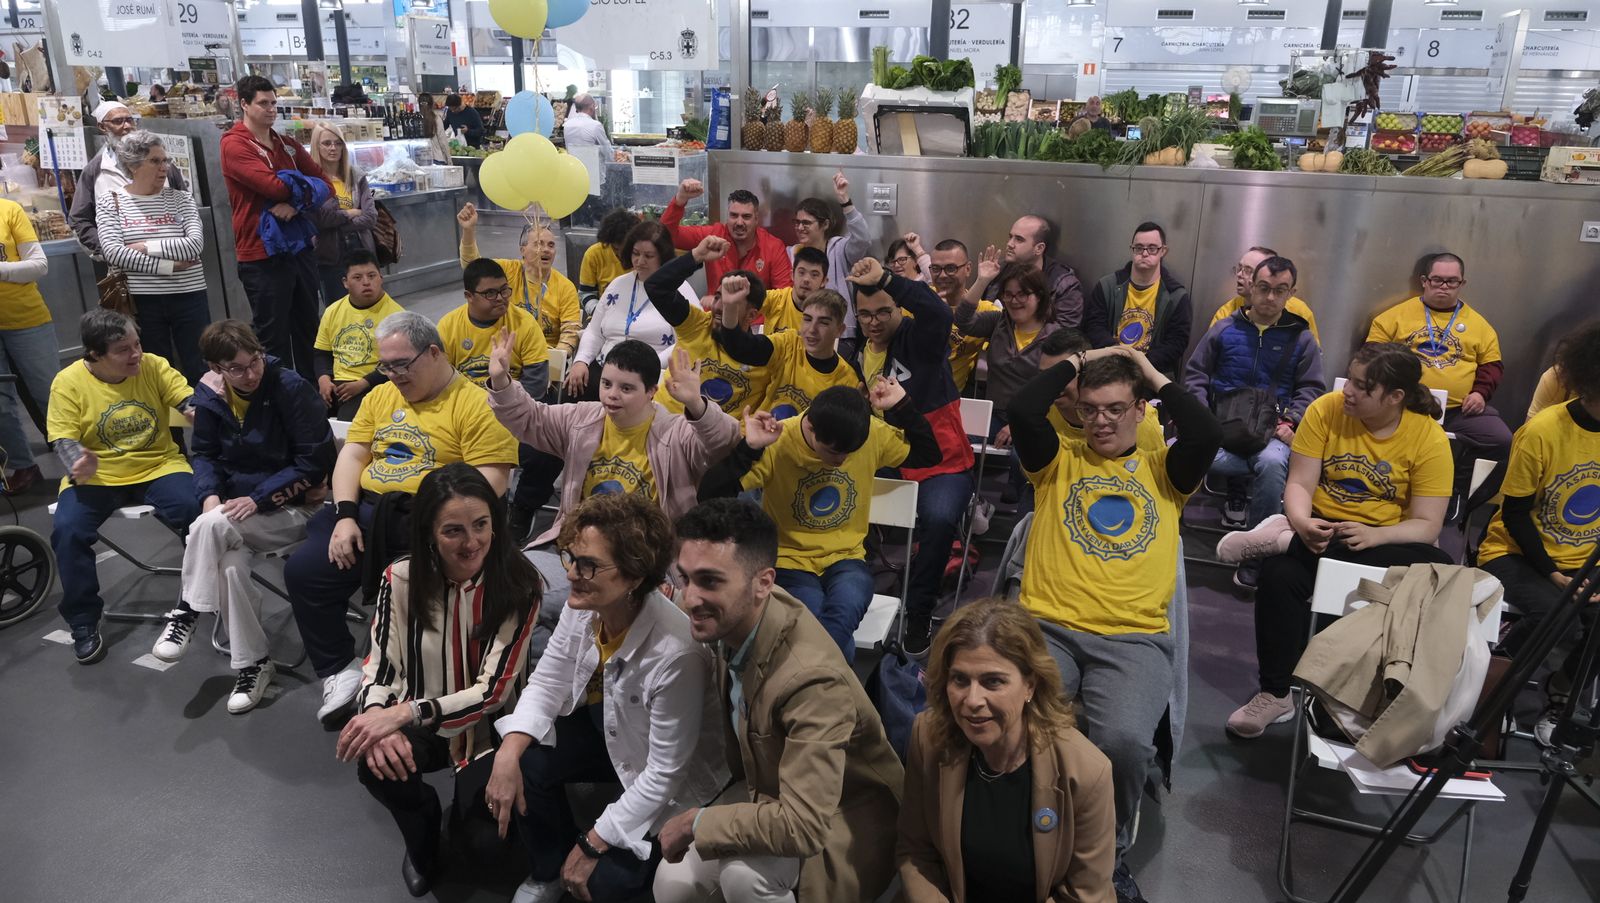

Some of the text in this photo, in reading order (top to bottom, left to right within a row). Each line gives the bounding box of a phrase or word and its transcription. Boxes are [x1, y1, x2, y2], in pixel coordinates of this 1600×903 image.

[116, 6, 134, 14] JOSÉ
[178, 3, 198, 23] 29
[20, 18, 35, 28] 28
[436, 24, 448, 39] 27
[293, 36, 306, 48] B-
[1113, 37, 1123, 53] 7
[1428, 40, 1440, 57] 8
[650, 51, 672, 60] C-5.3
[592, 466, 635, 484] ASALSIDO
[805, 476, 844, 489] ASALSIDO
[1335, 463, 1380, 487] ASALSIDO
[1566, 471, 1600, 489] ASALSI
[1085, 530, 1102, 547] VEN
[1132, 534, 1144, 544] LA
[1140, 503, 1152, 534] CHAPA
